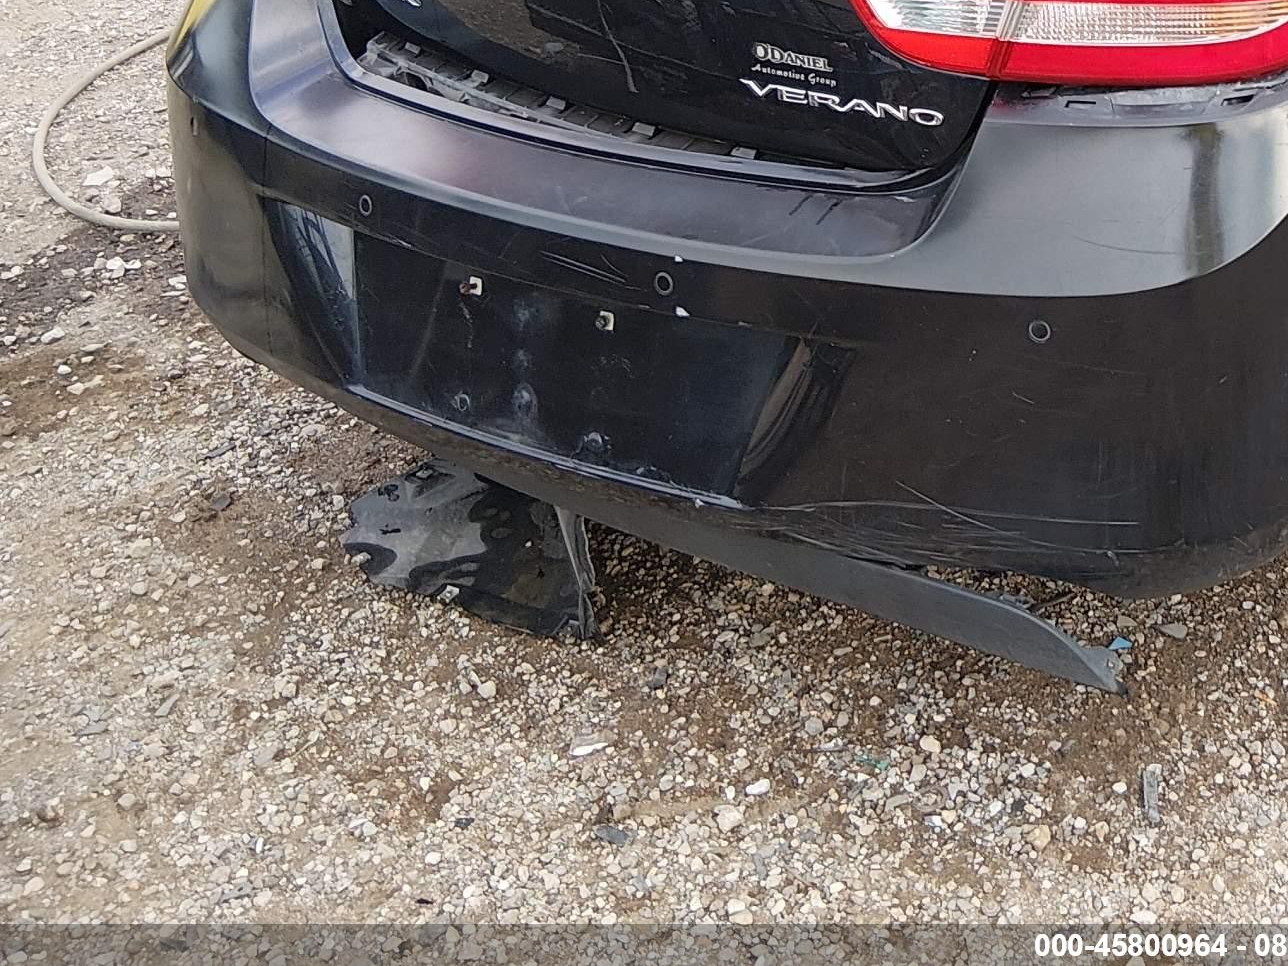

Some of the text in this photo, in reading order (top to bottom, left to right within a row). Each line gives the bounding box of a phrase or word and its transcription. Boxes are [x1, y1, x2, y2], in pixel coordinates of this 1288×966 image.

[751, 63, 837, 88] Automotive Group
[738, 78, 945, 126] VERANO
